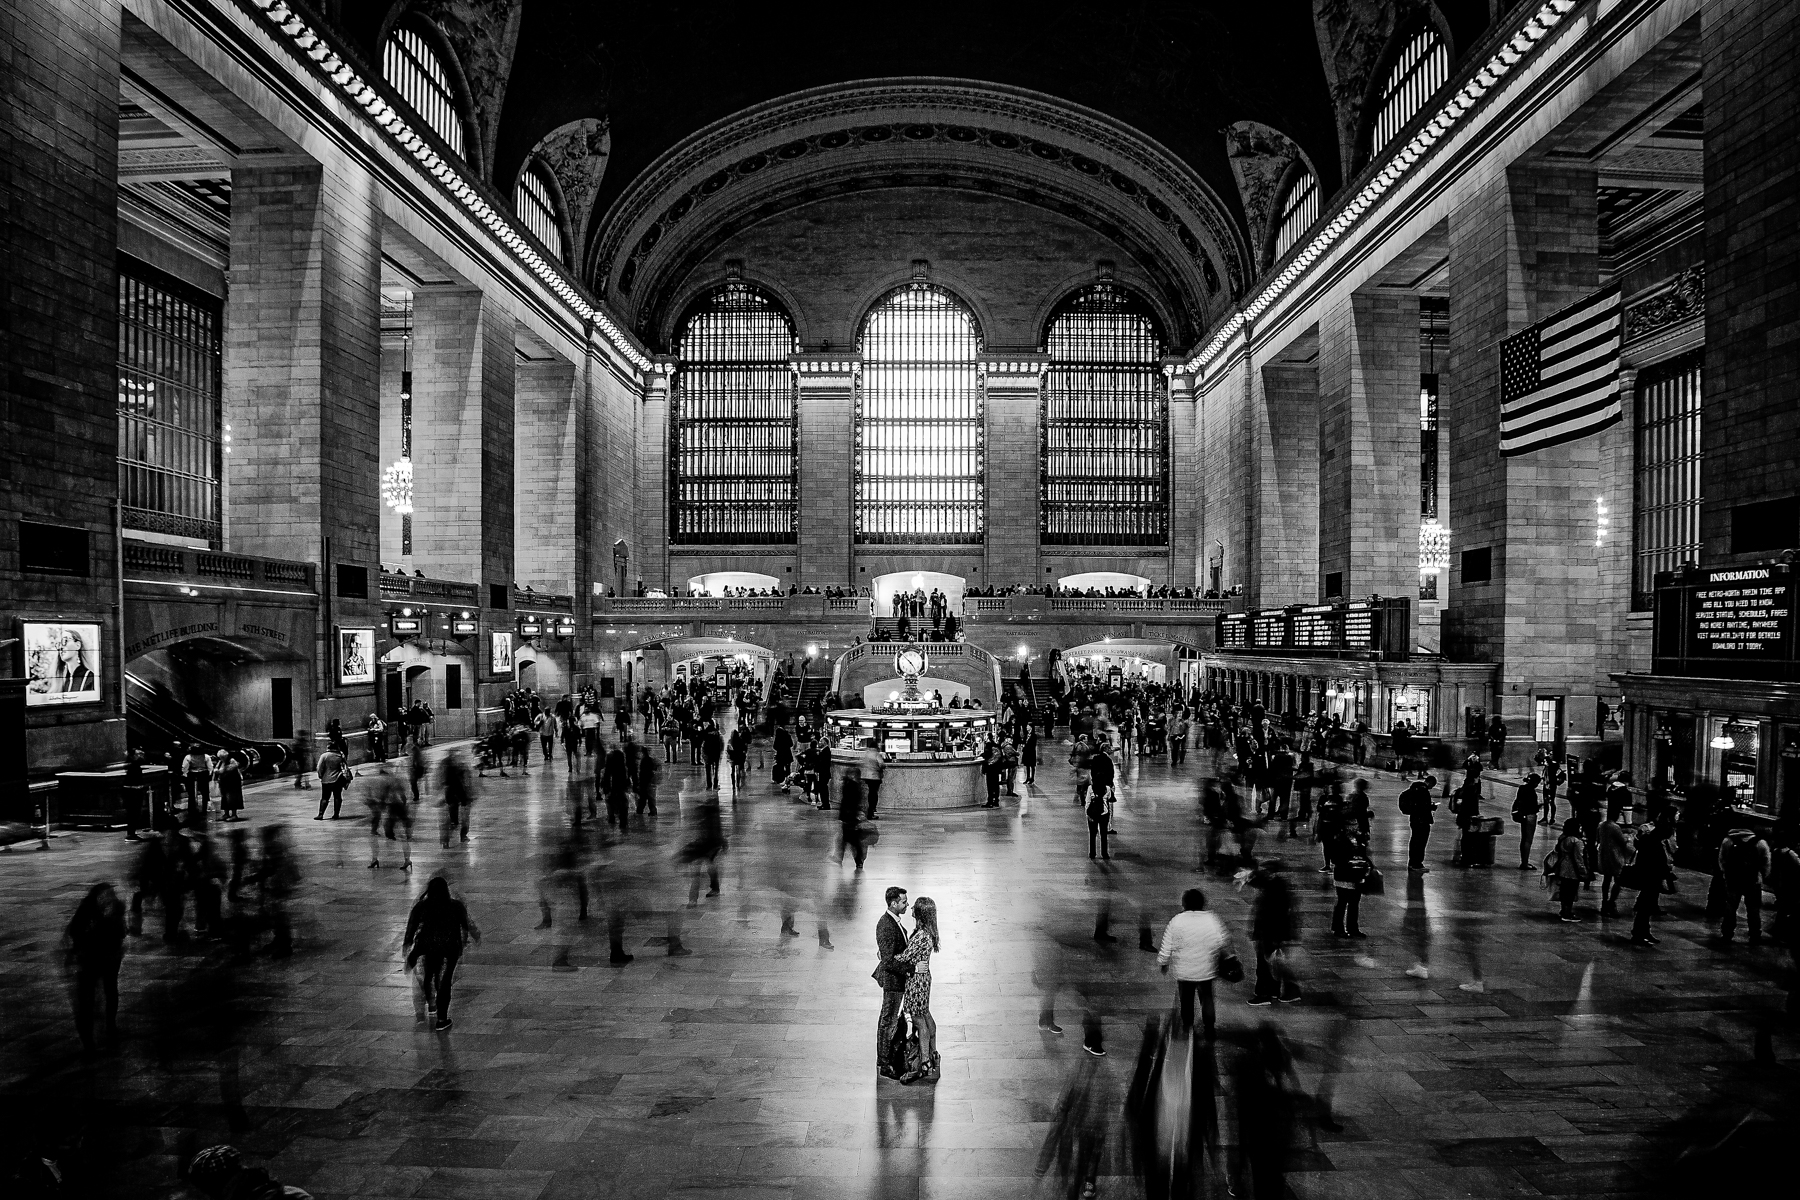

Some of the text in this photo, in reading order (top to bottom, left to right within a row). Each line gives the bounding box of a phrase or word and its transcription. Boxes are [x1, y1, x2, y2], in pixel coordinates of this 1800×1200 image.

[1710, 569, 1769, 582] INFORMATION
[1709, 589, 1740, 598] METRO-NORTH
[125, 622, 218, 658] THE METLIFE BUILDING
[261, 627, 286, 641] STREET
